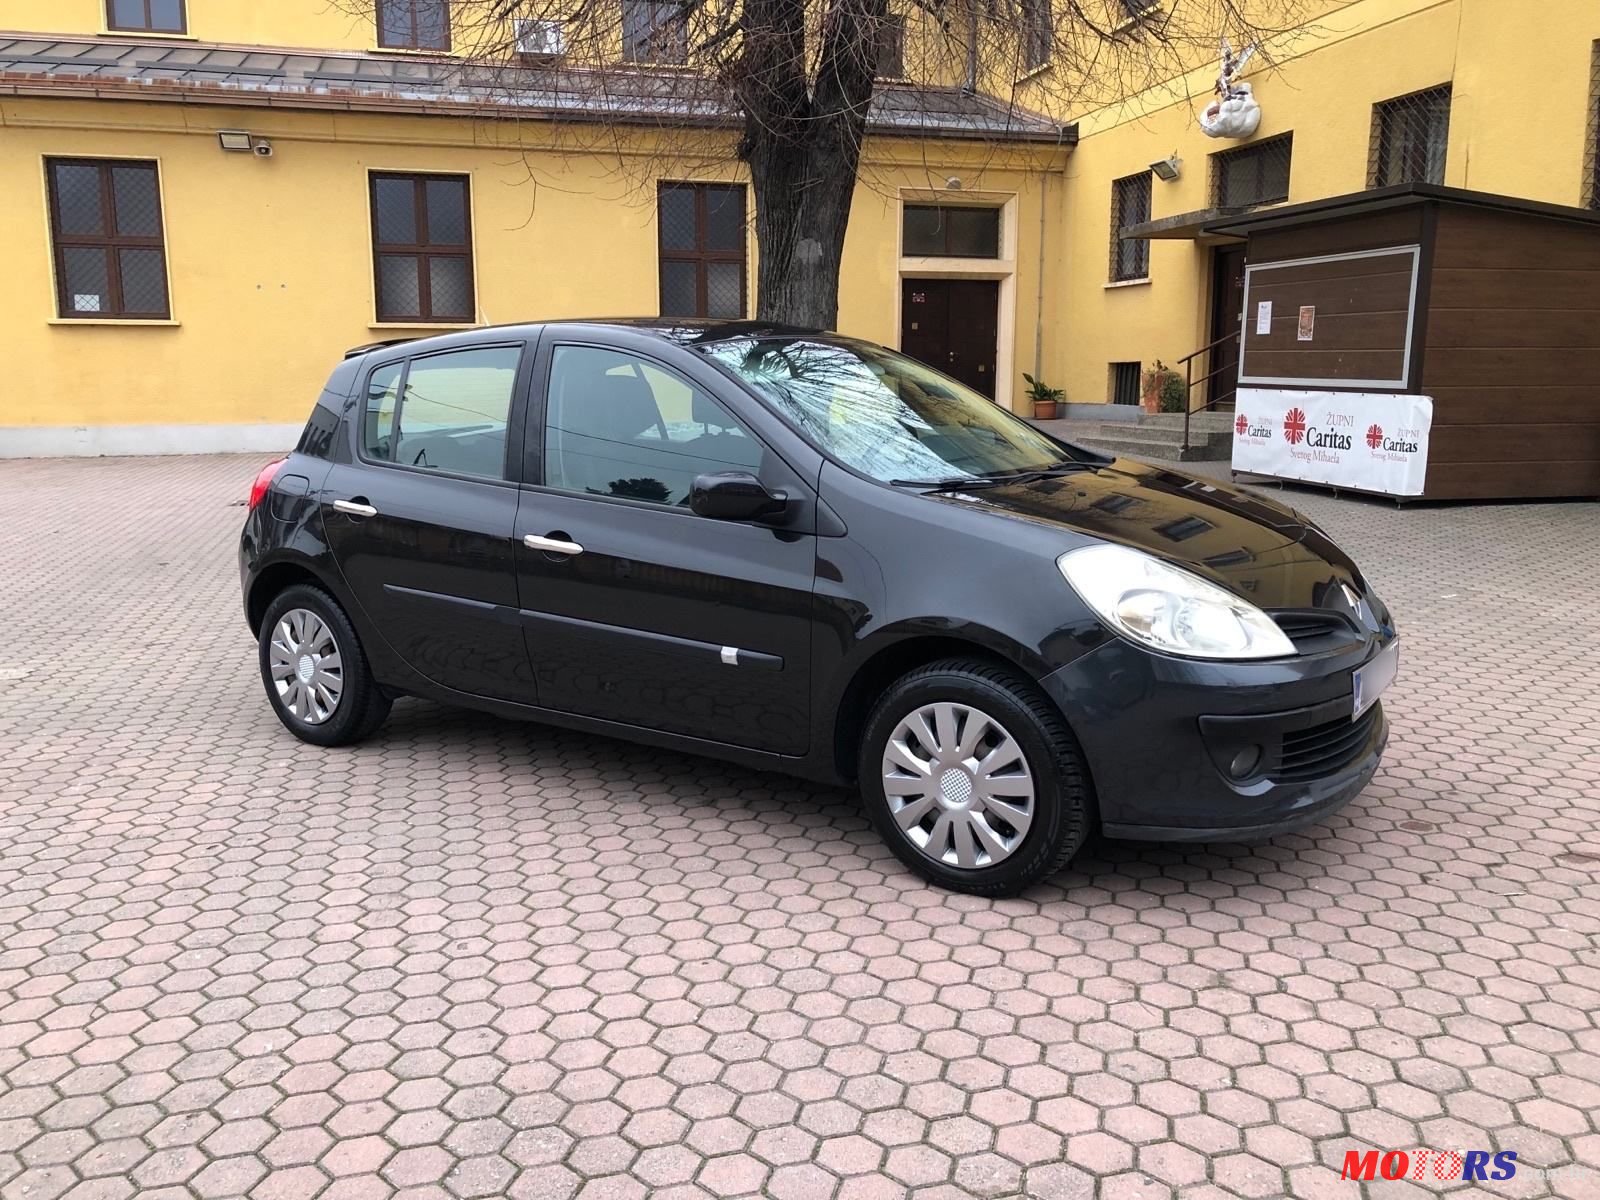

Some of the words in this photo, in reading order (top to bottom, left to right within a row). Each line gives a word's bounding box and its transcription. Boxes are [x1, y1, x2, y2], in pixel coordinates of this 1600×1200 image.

[1326, 411, 1354, 427] ŽUPNI
[1247, 424, 1272, 438] Caritas
[1306, 426, 1352, 450] Caritas
[1383, 437, 1418, 453] Caritas
